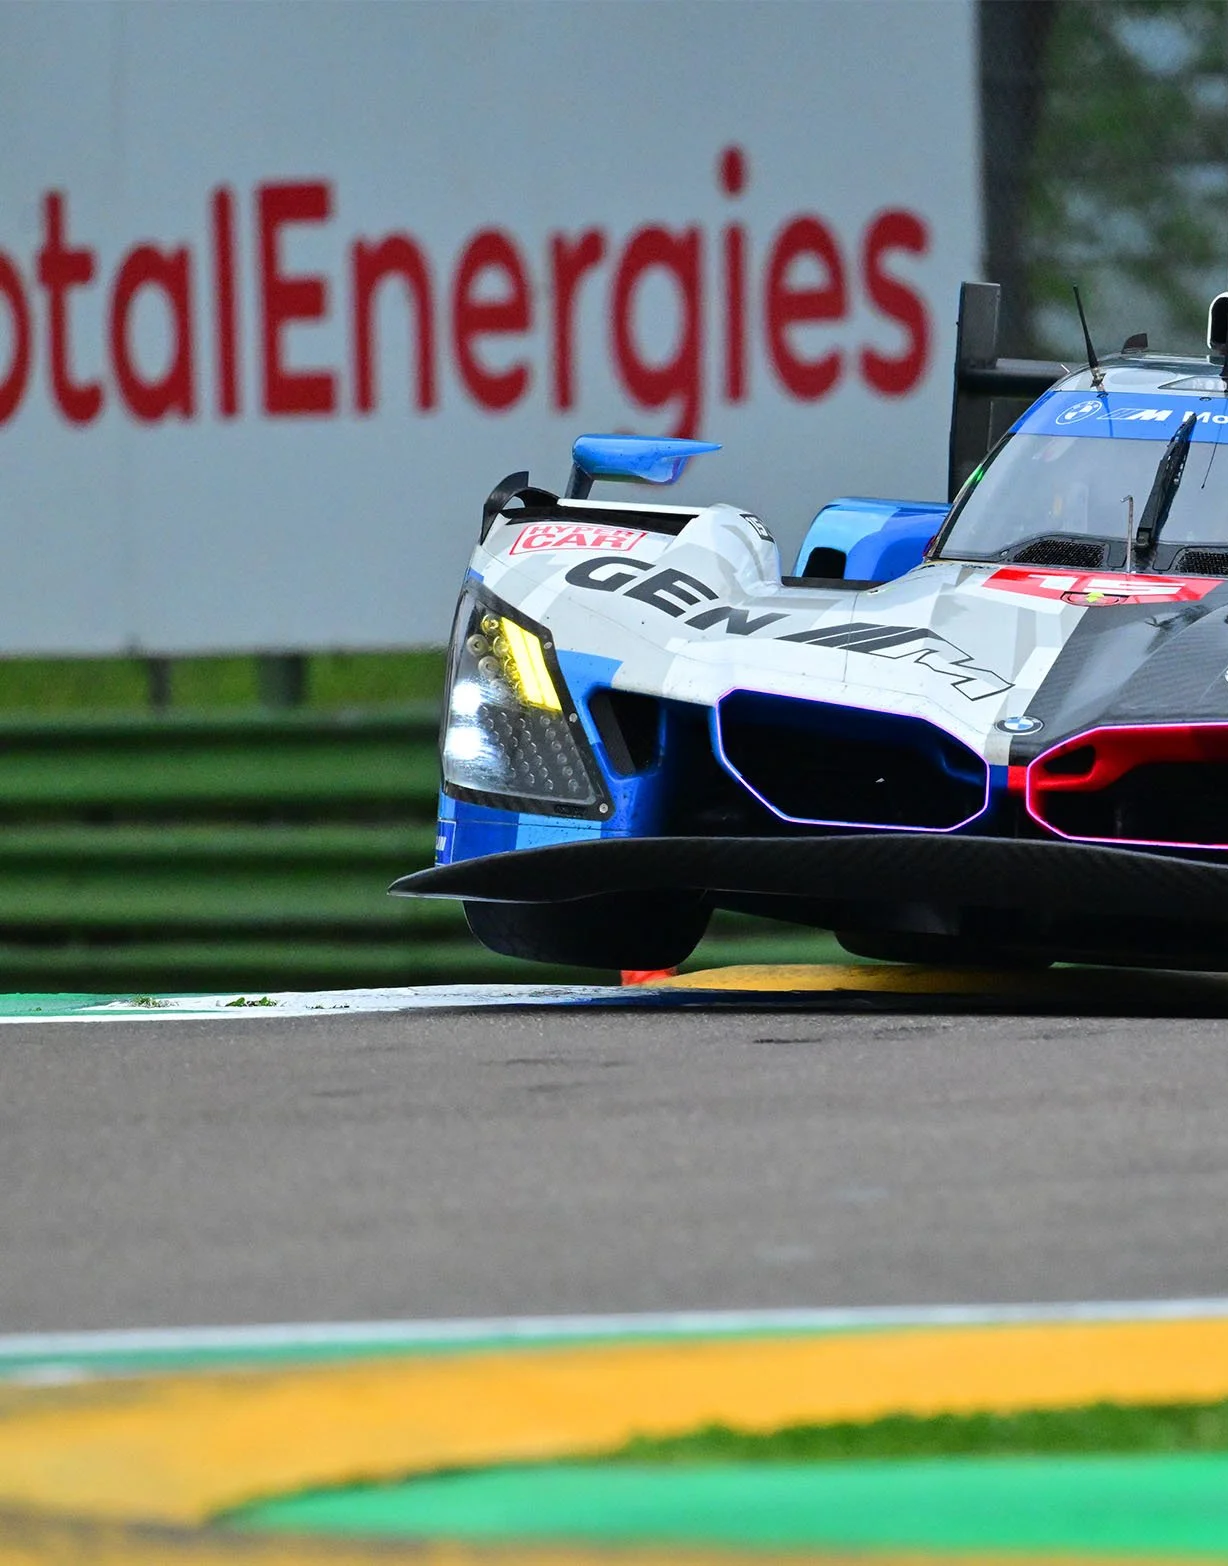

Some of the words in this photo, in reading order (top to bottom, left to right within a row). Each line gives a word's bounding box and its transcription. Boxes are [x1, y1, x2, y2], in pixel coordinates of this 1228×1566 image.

[529, 525, 634, 537] HYPER
[522, 533, 627, 549] CAR
[1028, 574, 1187, 596] 15
[565, 556, 790, 636] GEN
